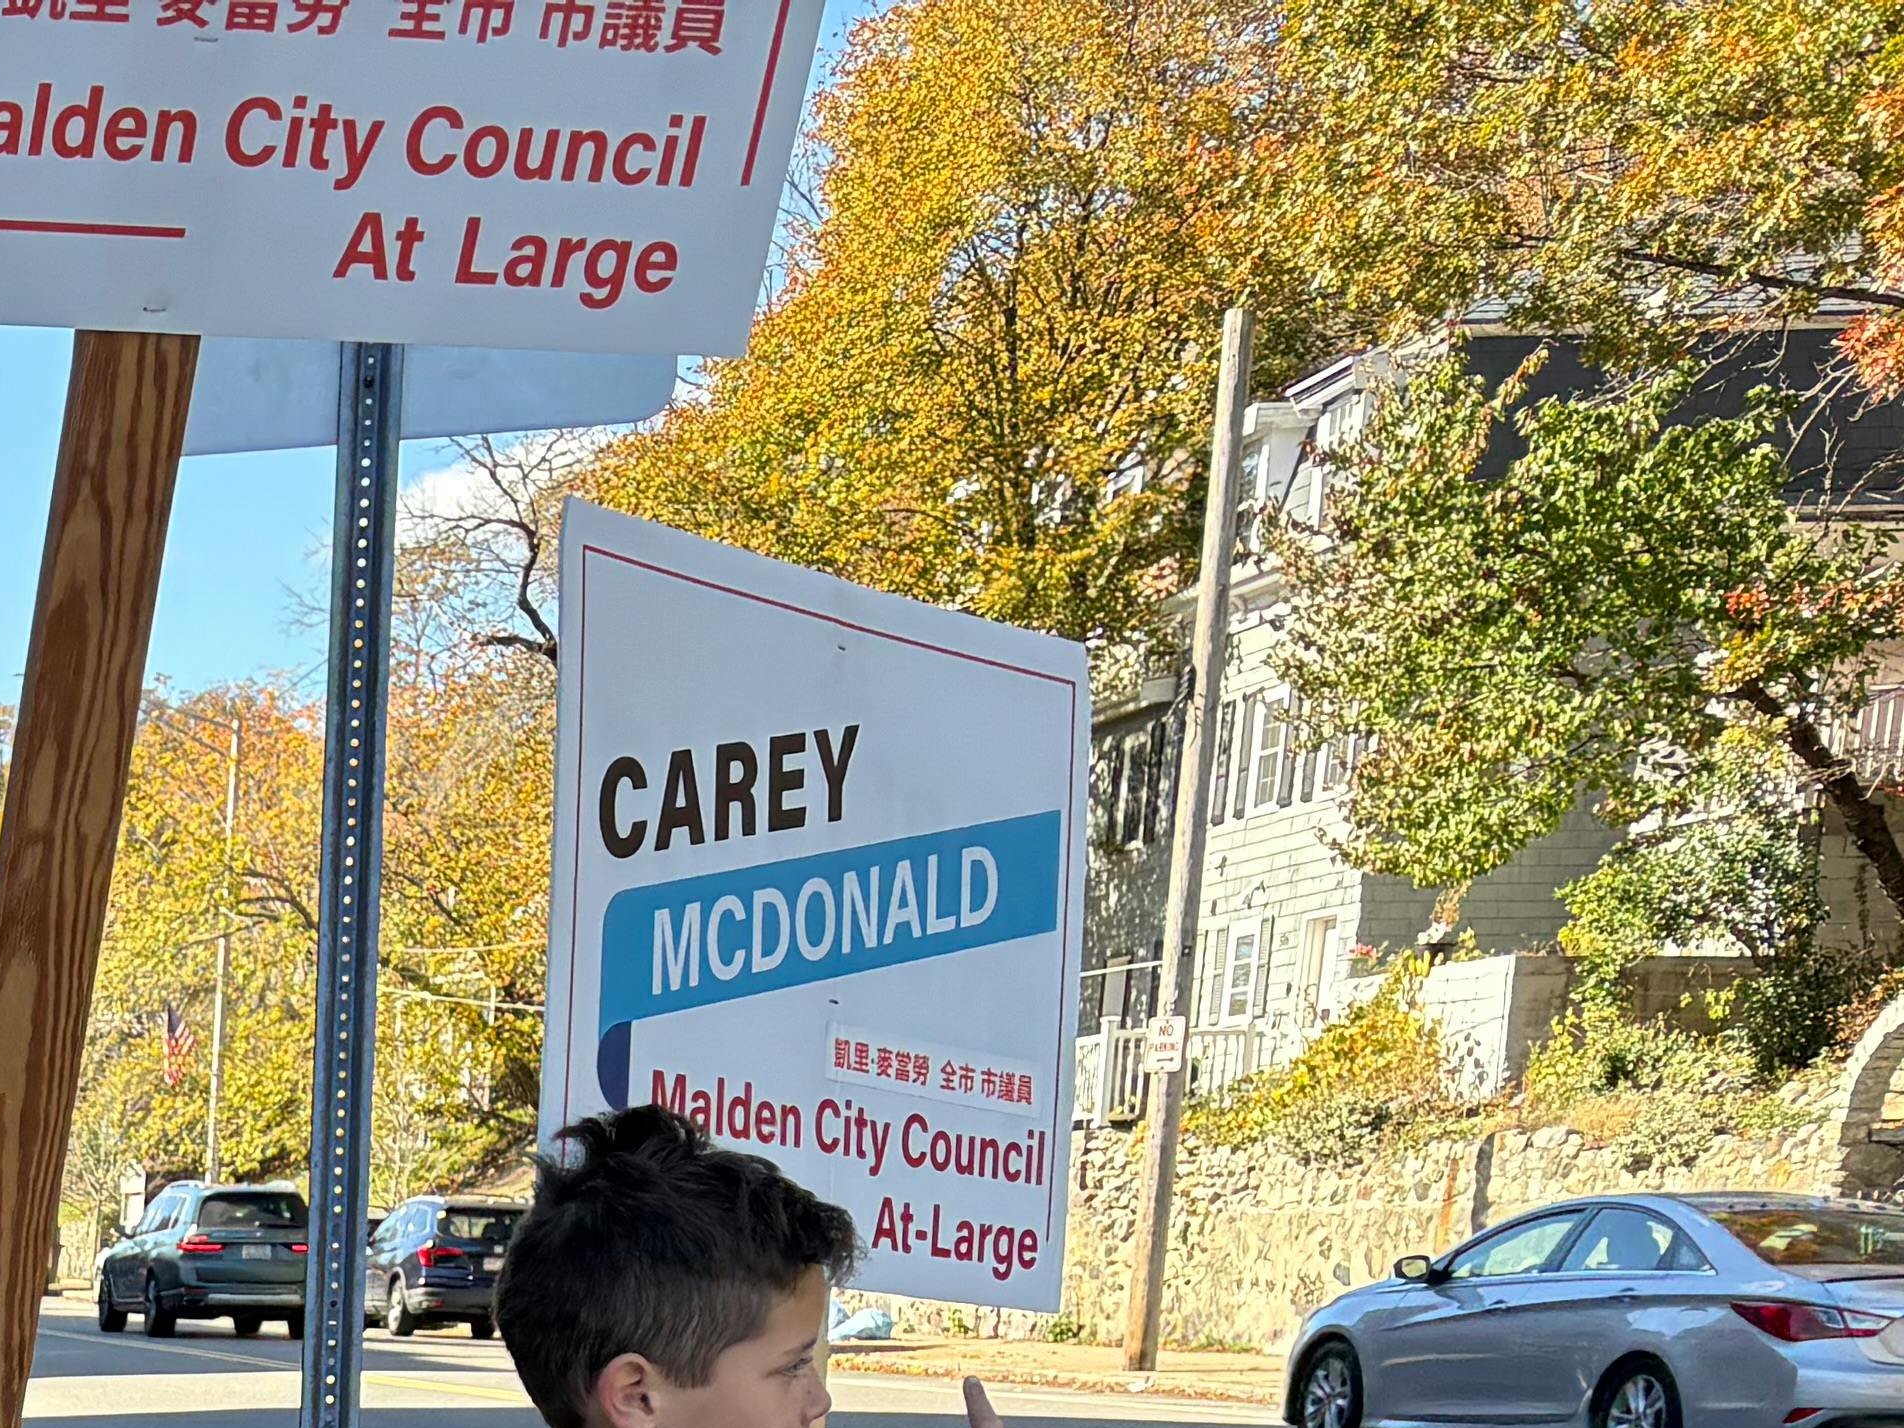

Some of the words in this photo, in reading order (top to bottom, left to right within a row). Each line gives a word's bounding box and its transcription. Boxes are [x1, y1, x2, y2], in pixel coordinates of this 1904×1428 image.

[226, 97, 385, 190] City
[406, 107, 706, 188] Council
[334, 213, 424, 282] At
[457, 218, 678, 308] Large
[599, 724, 860, 861] CAREY
[652, 845, 998, 996] MCDONALD
[1158, 1024, 1174, 1037] NO
[651, 1070, 802, 1149] Malden
[815, 1099, 891, 1177] City
[902, 1115, 1044, 1186] Council
[940, 1059, 976, 1094] 全市
[980, 1067, 1033, 1106] 市議員
[872, 1197, 1038, 1281] At-Large
